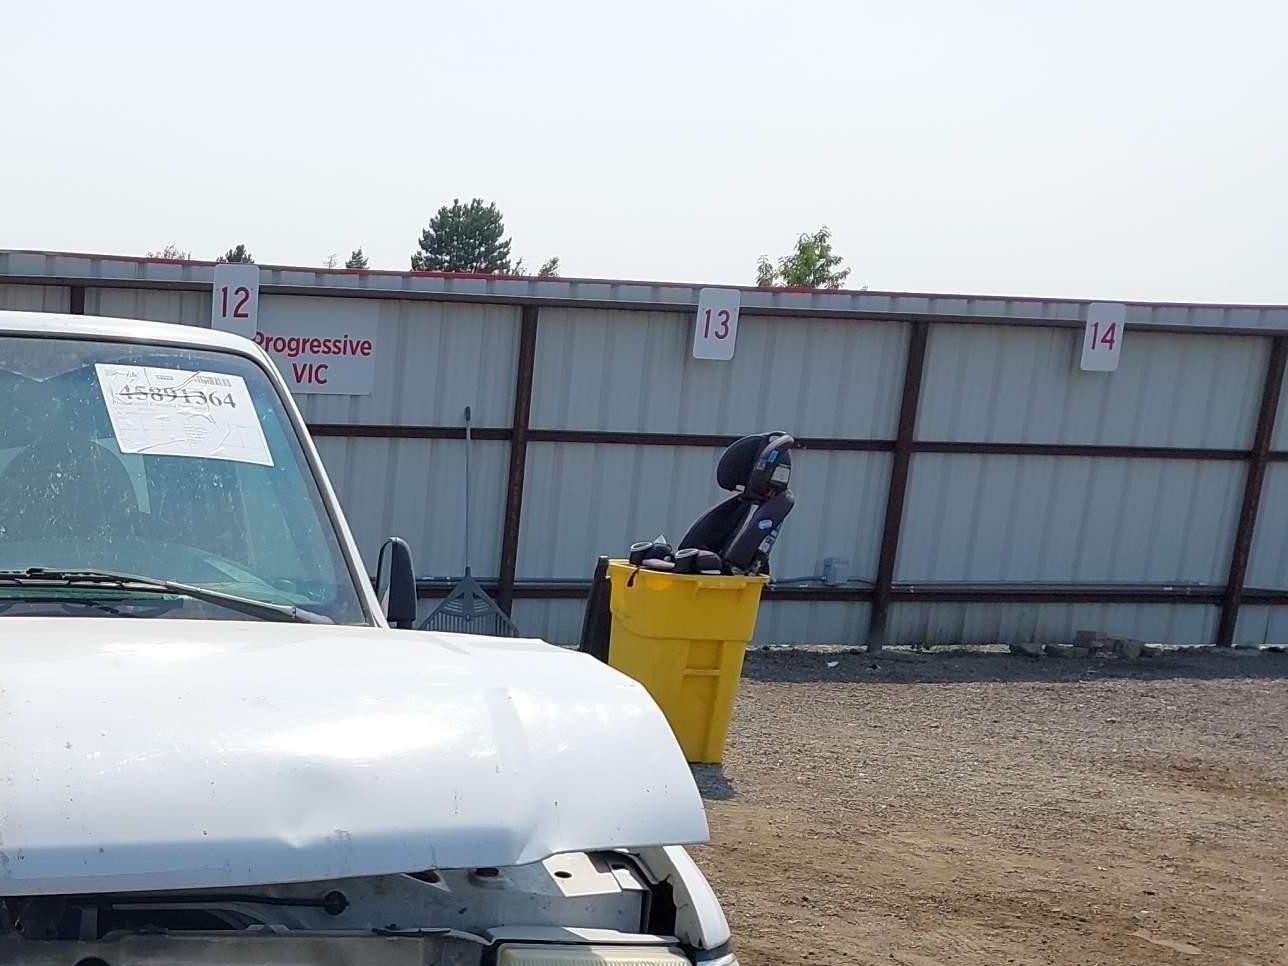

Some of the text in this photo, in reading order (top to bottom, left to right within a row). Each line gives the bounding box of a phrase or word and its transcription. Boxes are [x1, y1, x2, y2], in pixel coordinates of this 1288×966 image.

[220, 286, 250, 318] 12
[703, 309, 730, 340] 13
[1091, 321, 1116, 350] 14
[253, 331, 373, 358] Progressive
[292, 362, 329, 385] VIC
[118, 384, 237, 409] 45891364
